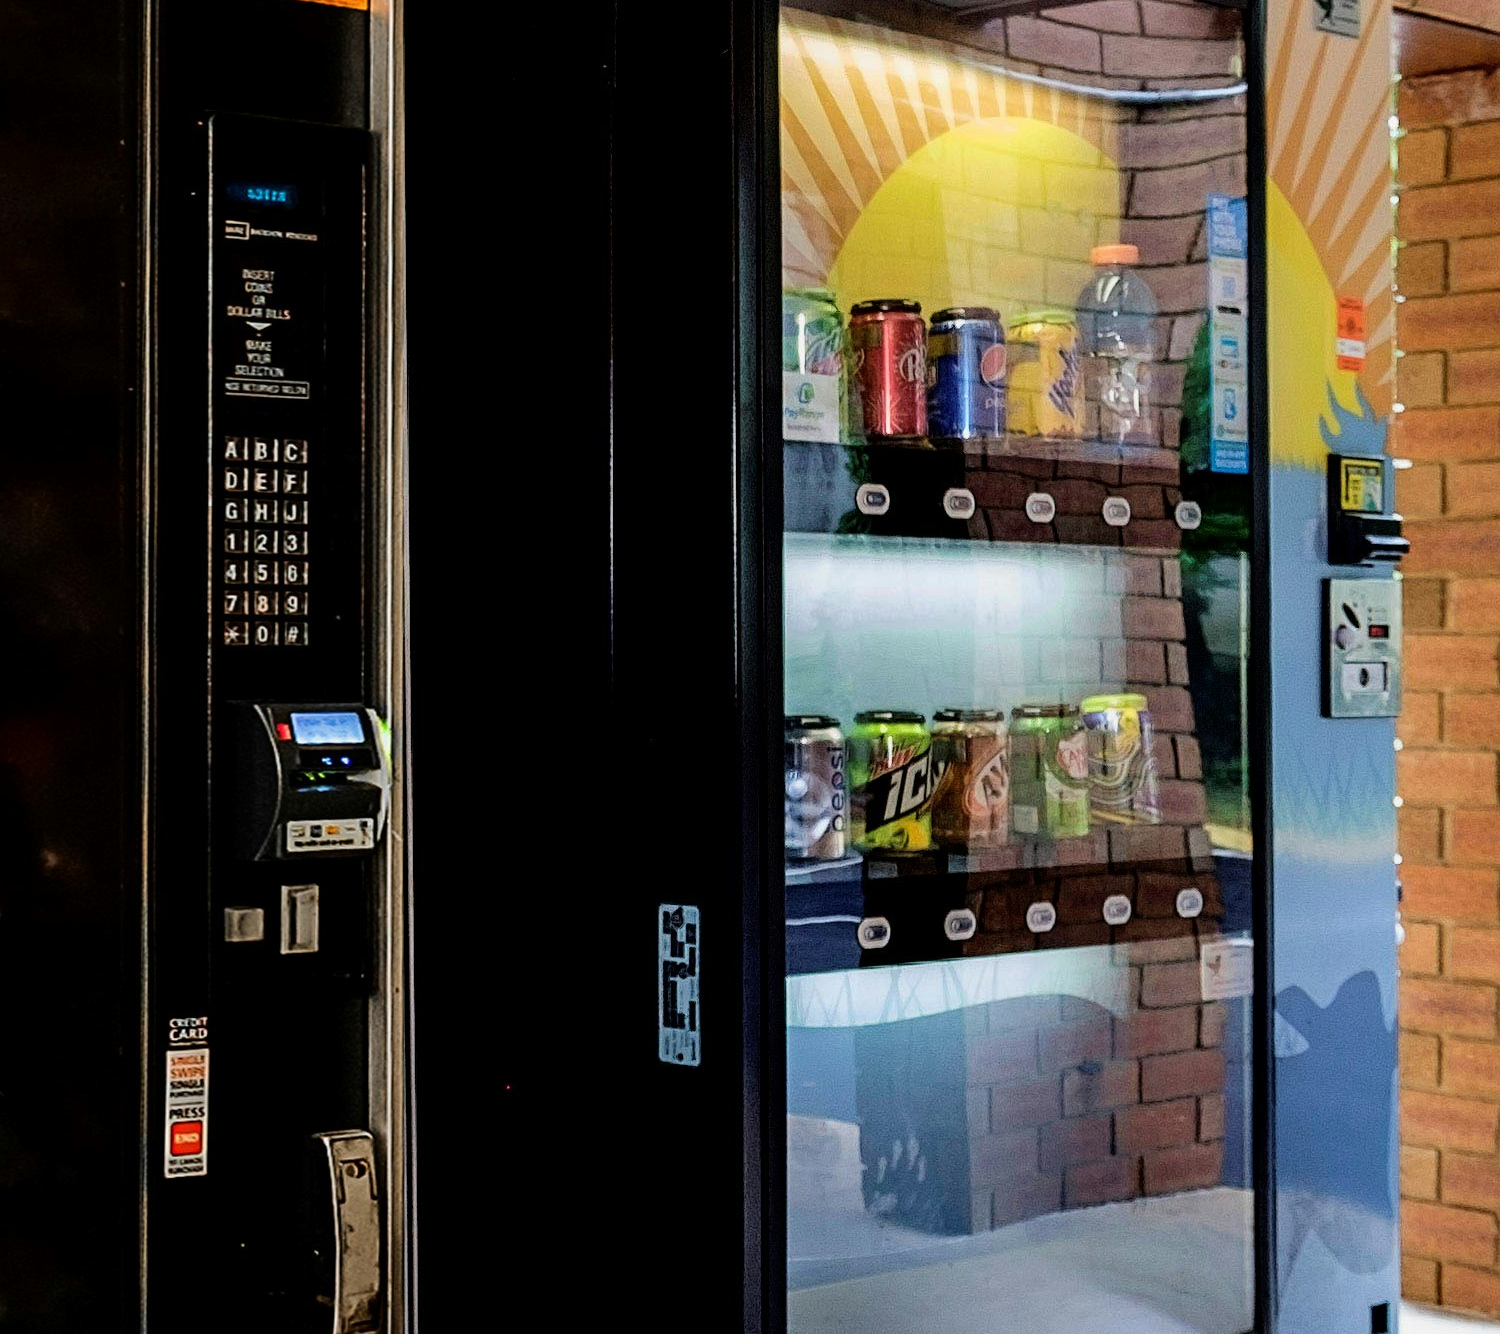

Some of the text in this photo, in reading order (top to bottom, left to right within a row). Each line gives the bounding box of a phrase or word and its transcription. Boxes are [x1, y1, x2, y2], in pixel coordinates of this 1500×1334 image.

[227, 306, 291, 320] DOLLAR BILLS
[235, 365, 284, 377] SELECTION
[225, 441, 299, 461] A B C
[225, 471, 297, 492] D E F
[225, 501, 297, 521] G H J
[227, 533, 298, 552] 1 2 3
[226, 564, 298, 582] 4 5 6
[225, 595, 299, 613] 7 8 9
[257, 625, 299, 643] 0 #
[169, 1027, 209, 1042] CARD
[169, 1106, 206, 1120] PRESS
